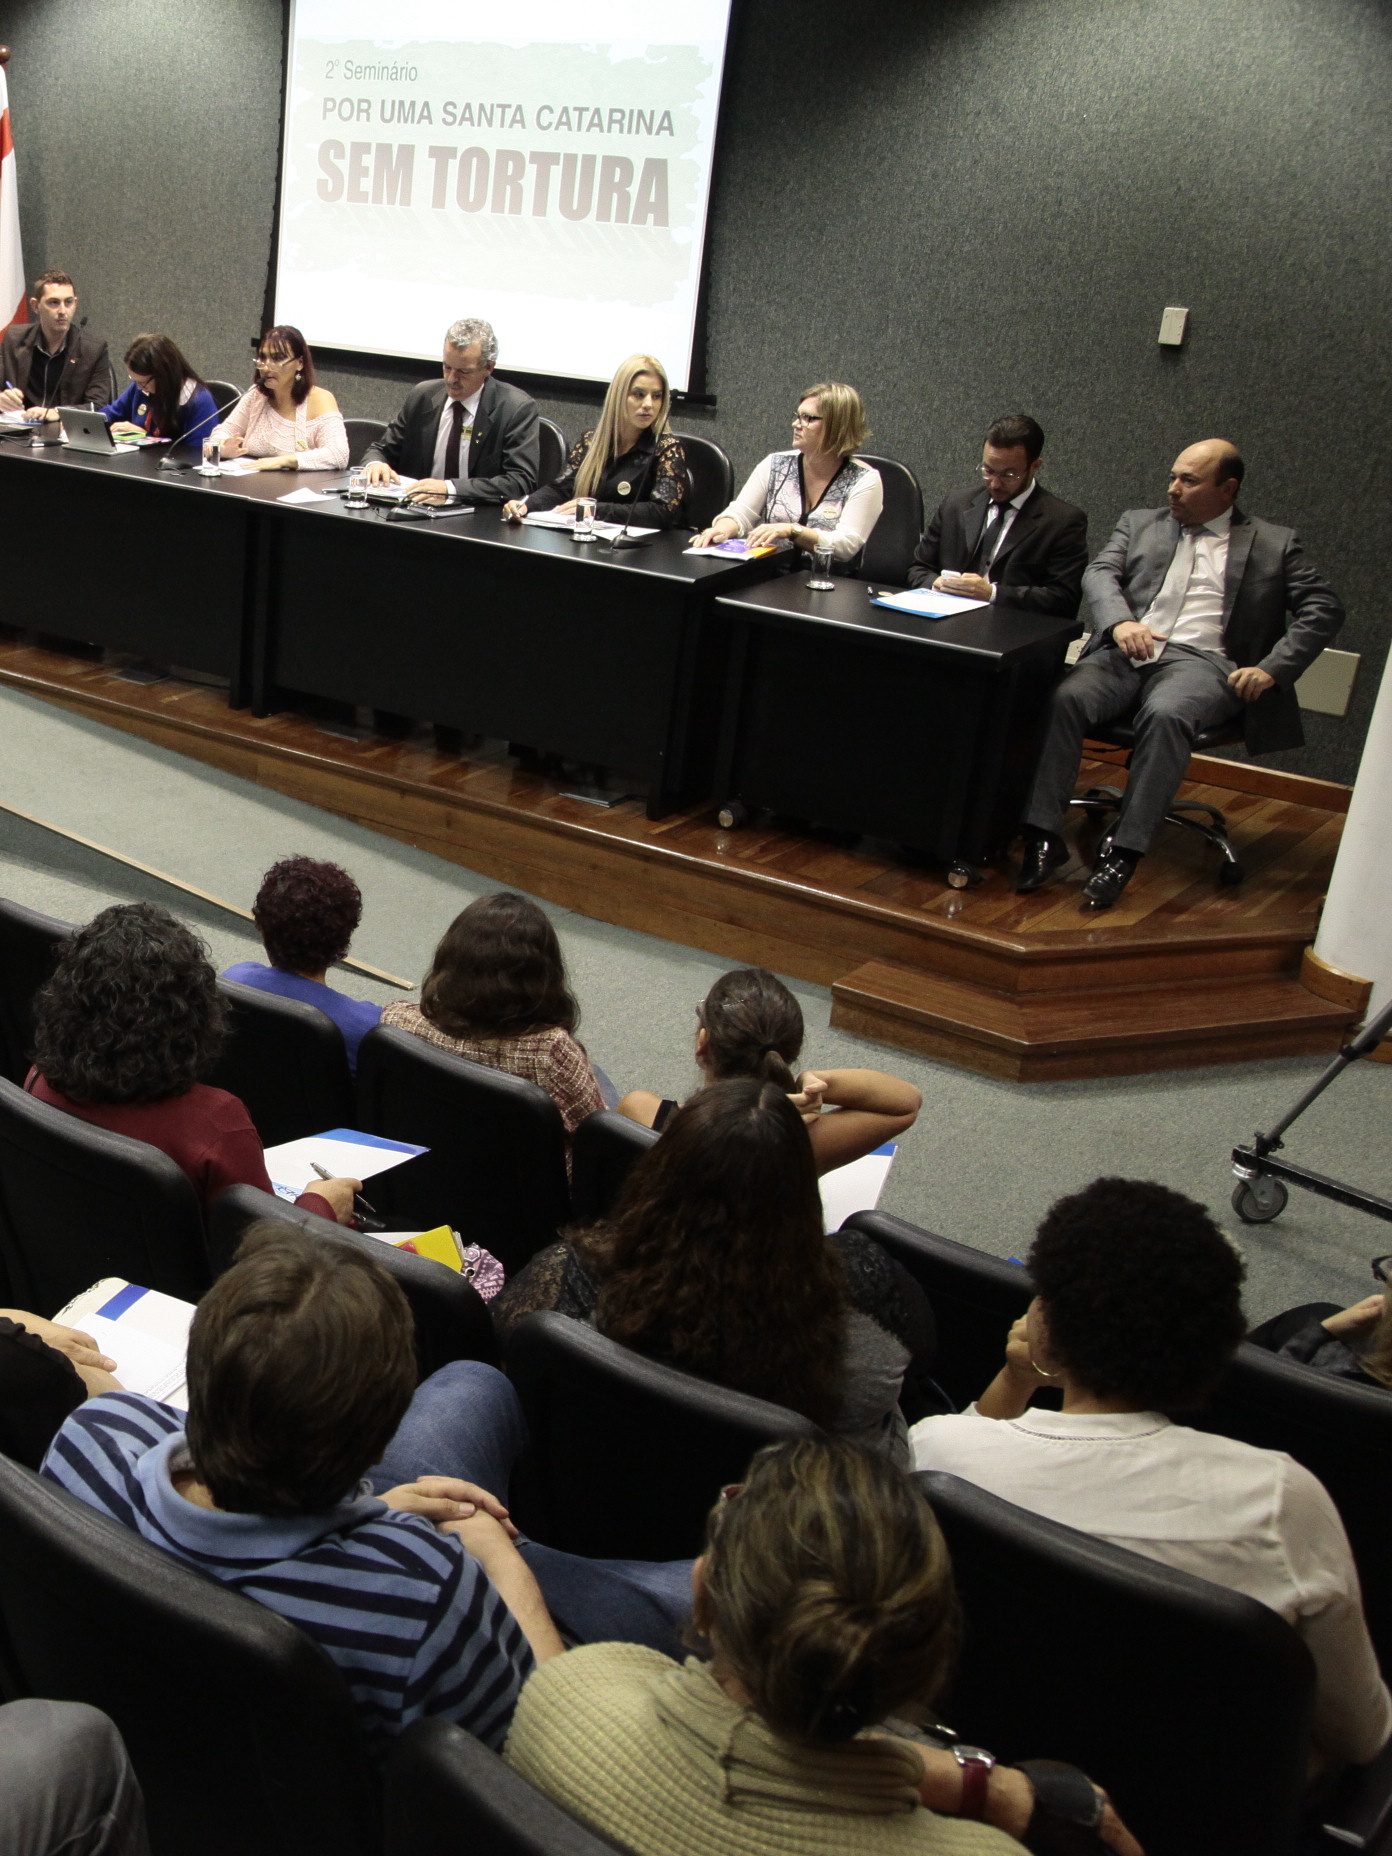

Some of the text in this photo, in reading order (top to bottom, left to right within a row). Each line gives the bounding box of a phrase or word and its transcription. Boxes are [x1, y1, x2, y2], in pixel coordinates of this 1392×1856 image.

[343, 60, 418, 81] Seminário
[321, 97, 675, 137] POR UMA SANTA CATARINA
[316, 138, 670, 228] SEM TORTURA
